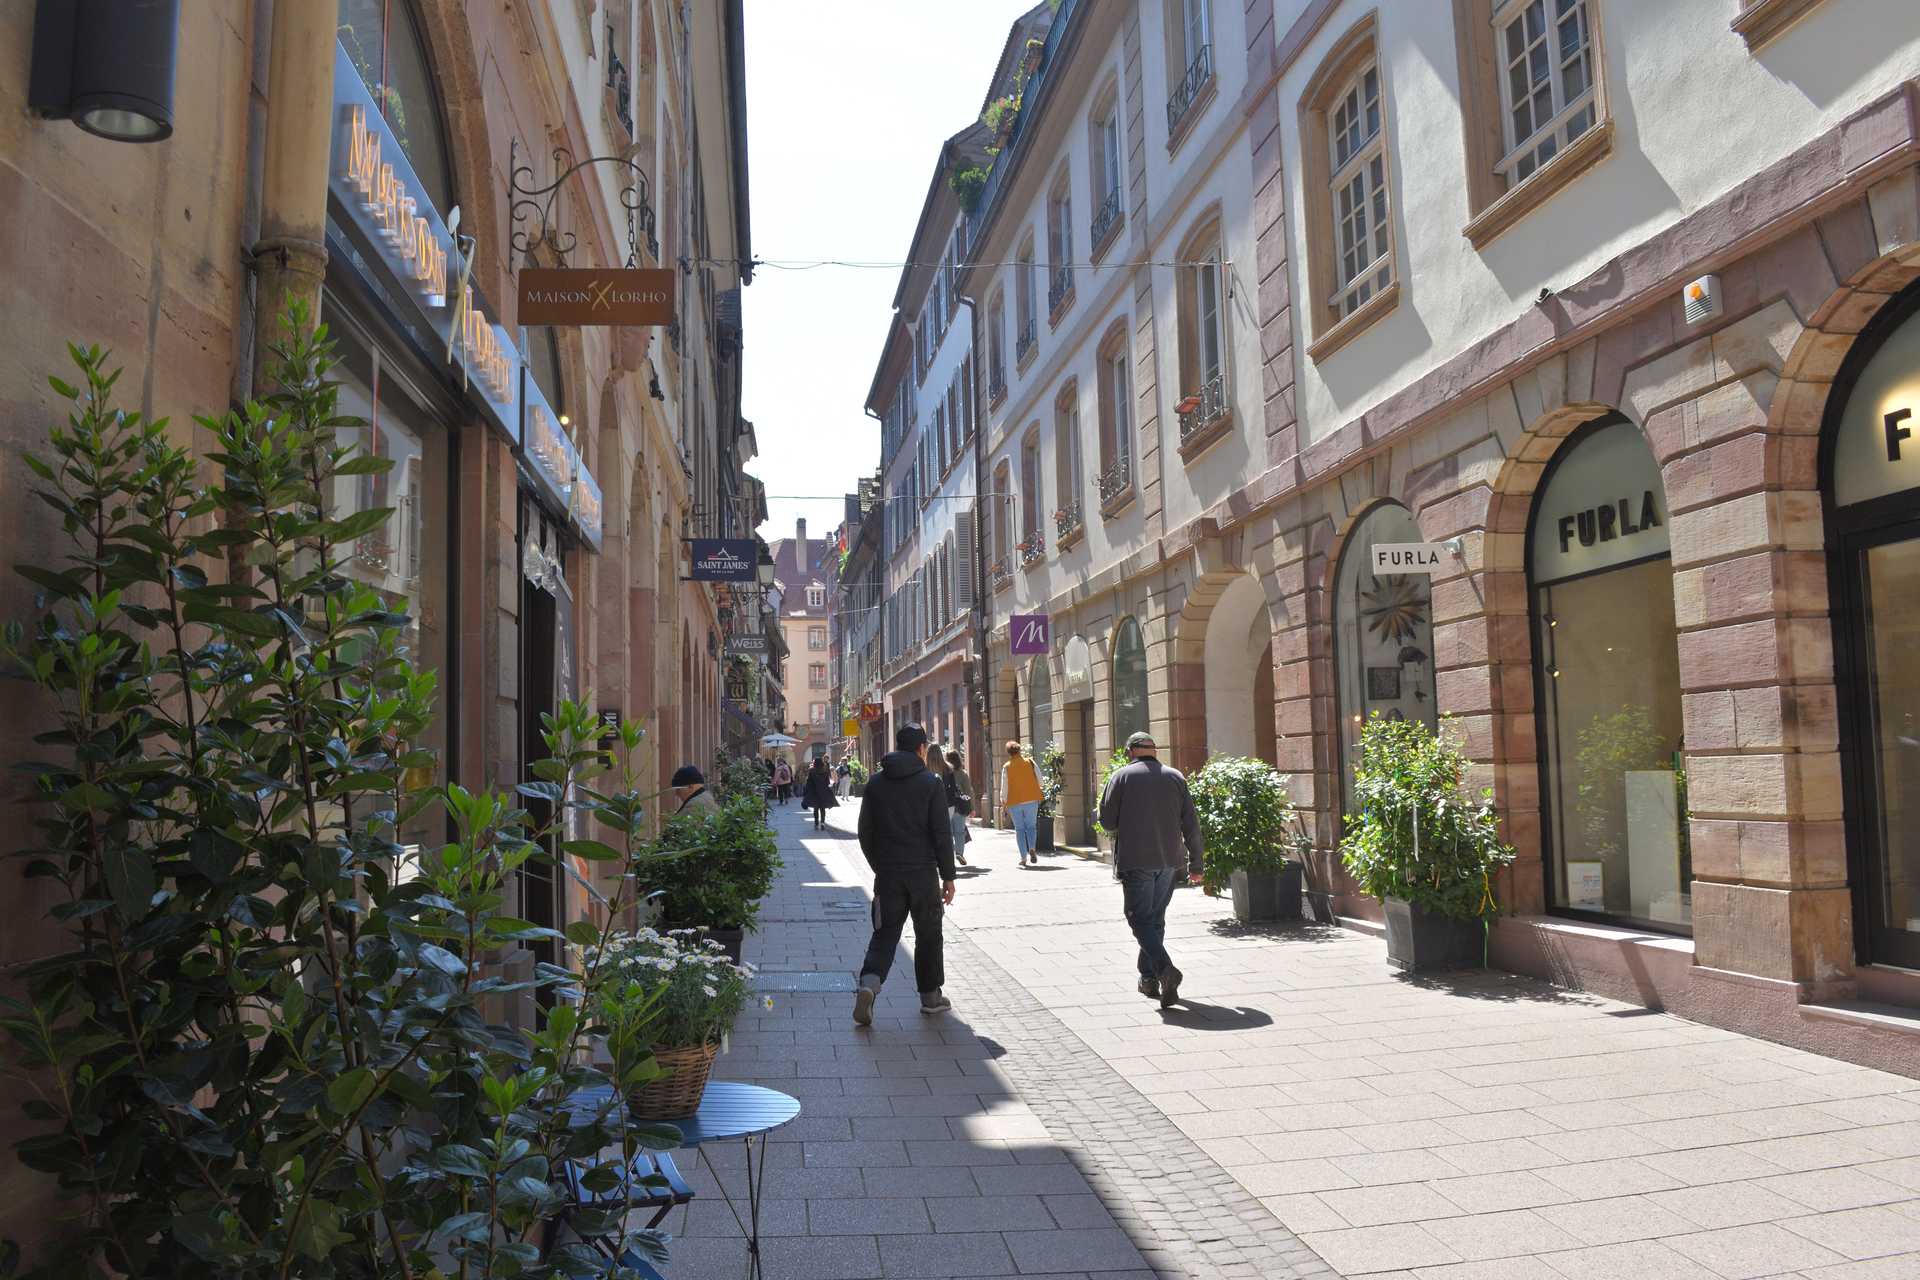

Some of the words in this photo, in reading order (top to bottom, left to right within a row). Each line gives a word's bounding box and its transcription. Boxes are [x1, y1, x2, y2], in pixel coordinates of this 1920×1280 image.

[527, 290, 592, 304] MAISON
[612, 290, 667, 304] LORHO
[1557, 490, 1664, 554] FURLA
[697, 560, 722, 569] SAINT
[722, 560, 749, 570] JAMES
[1378, 550, 1440, 566] FURLA
